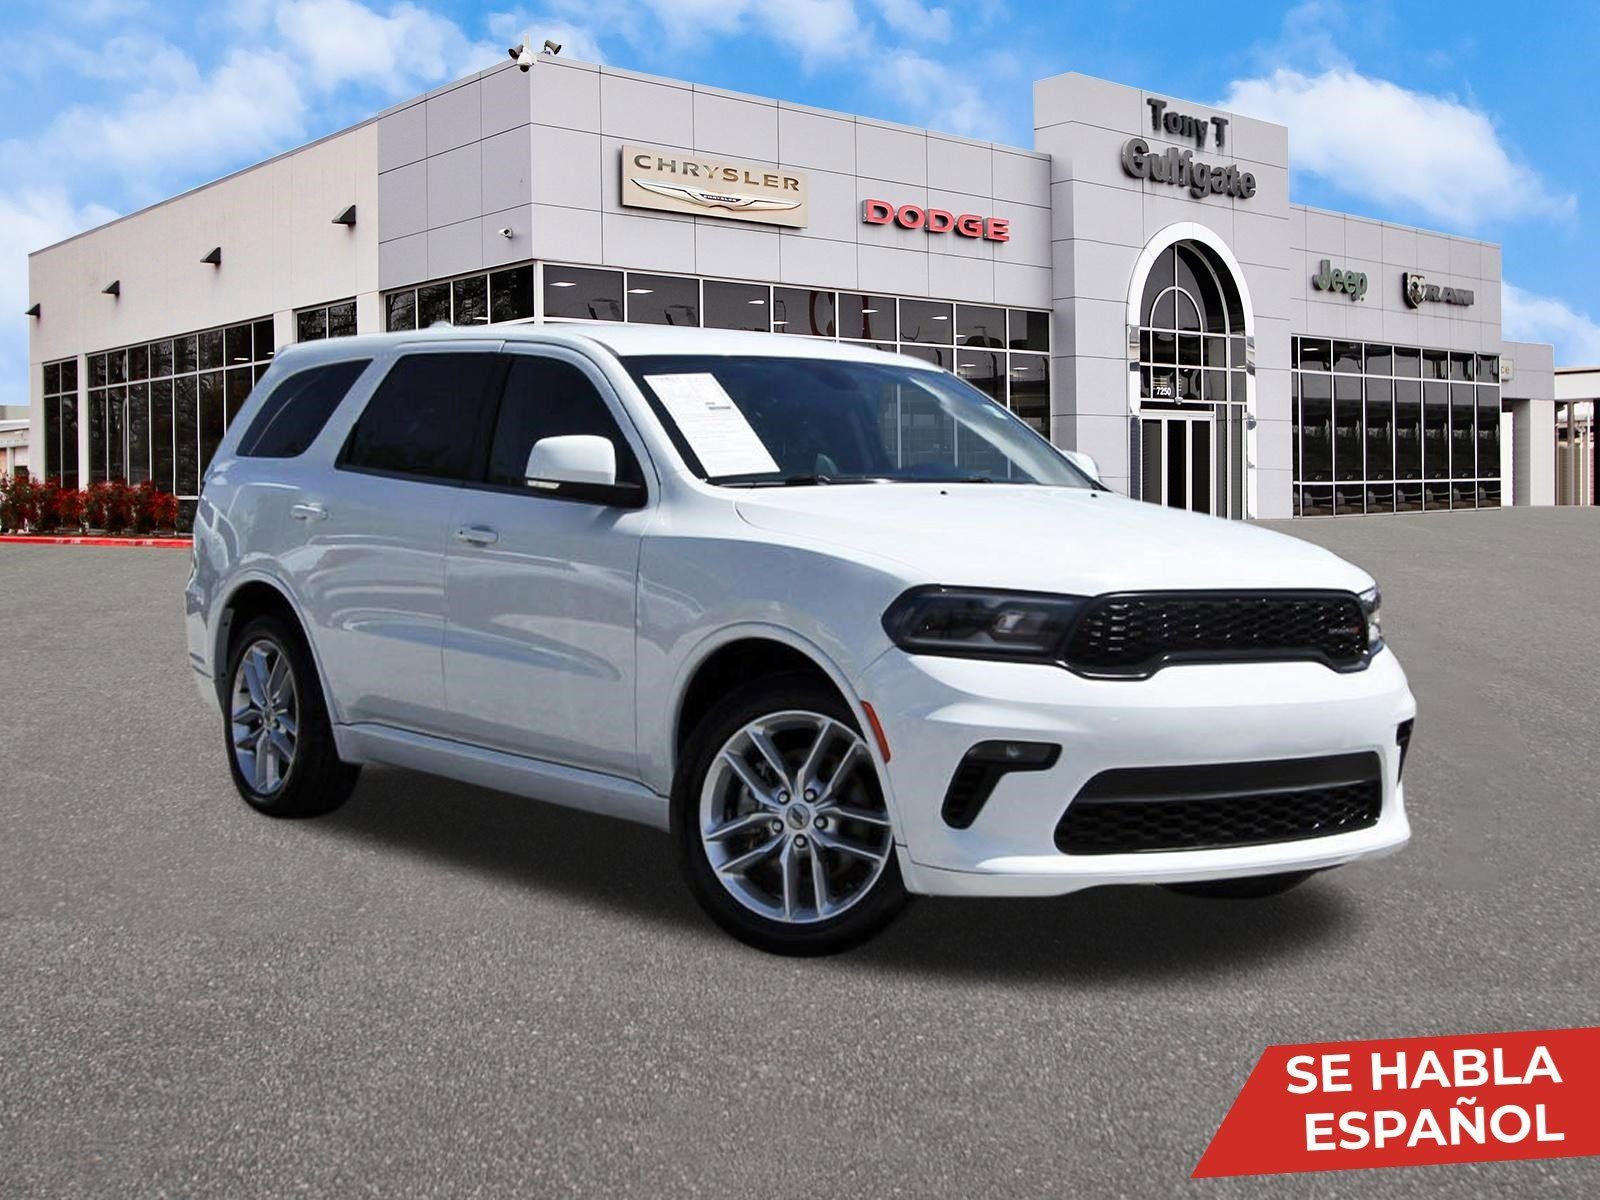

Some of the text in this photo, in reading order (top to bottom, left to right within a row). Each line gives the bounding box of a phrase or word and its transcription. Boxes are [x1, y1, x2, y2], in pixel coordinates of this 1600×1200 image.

[1146, 98, 1229, 148] Tony T
[633, 154, 800, 192] CHRYSLER
[1122, 138, 1256, 198] Gulfgate
[862, 198, 1011, 242] DODGE
[1313, 259, 1368, 301] Jeep
[1424, 283, 1474, 306] RAM
[1156, 386, 1171, 395] 7250
